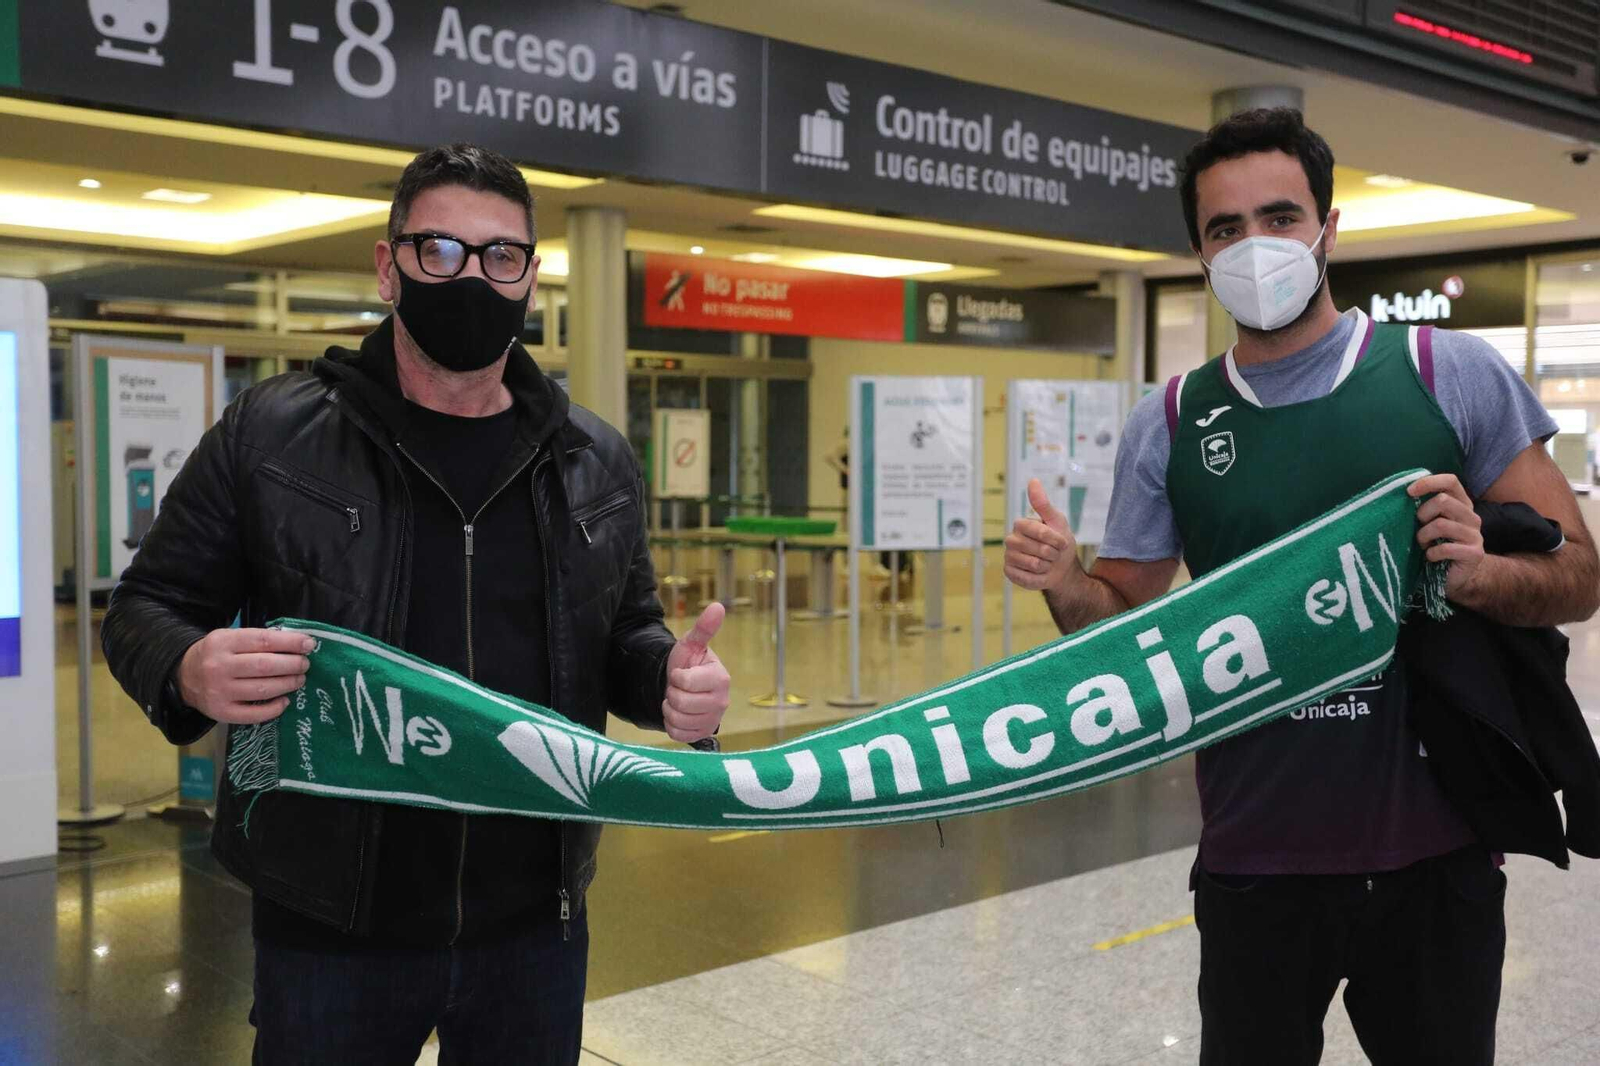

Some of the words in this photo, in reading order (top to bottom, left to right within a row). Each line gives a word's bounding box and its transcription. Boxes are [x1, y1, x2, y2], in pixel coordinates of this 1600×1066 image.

[232, 0, 397, 98] 1-8
[433, 5, 597, 83] Acceso
[612, 51, 639, 91] a
[652, 50, 737, 108] vías
[433, 76, 621, 137] PLATFORMS
[875, 94, 992, 155] Control
[1001, 119, 1040, 163] de
[1047, 135, 1178, 192] equipajes
[875, 149, 979, 192] LUGGAGE
[981, 163, 1070, 207] CONTROL
[702, 271, 731, 297] No
[735, 278, 789, 302] pasar
[956, 294, 1024, 323] Llegadas
[1371, 288, 1451, 323] k-tuin
[315, 687, 335, 726] Club
[722, 614, 1270, 810] Unicaja
